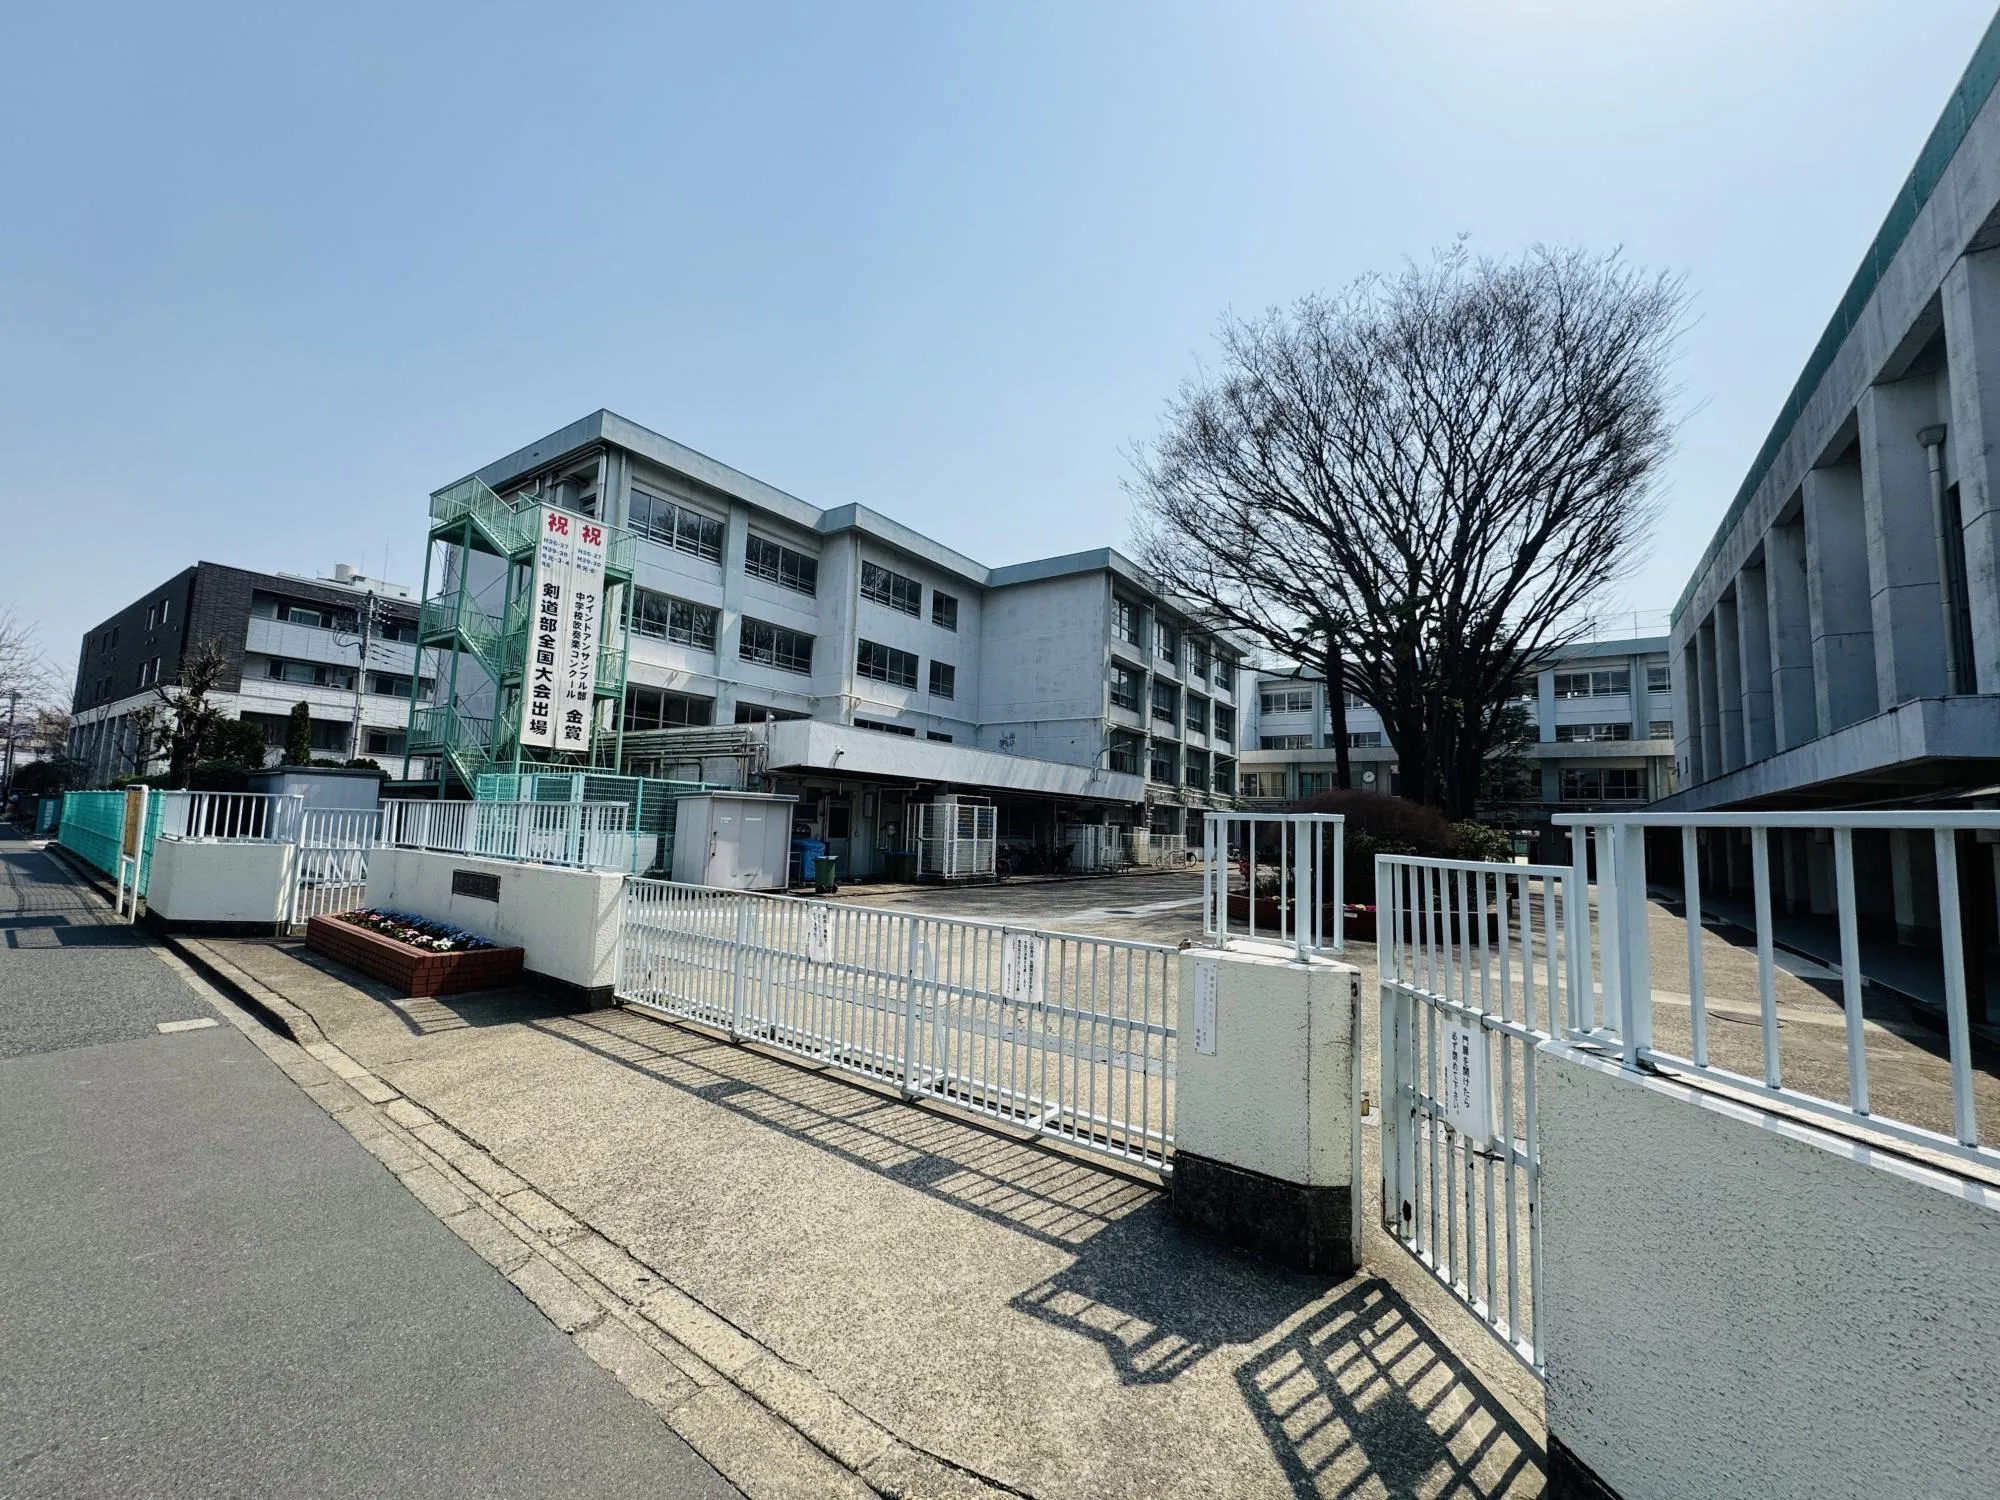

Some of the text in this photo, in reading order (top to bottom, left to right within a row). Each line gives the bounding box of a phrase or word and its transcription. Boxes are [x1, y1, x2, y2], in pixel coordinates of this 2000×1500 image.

[548, 512, 569, 536] 祝
[582, 524, 602, 547] 祝
[530, 582, 560, 736] 剣道部全国大会出場
[566, 592, 586, 699] 中学校吹奏楽コンクール
[564, 709, 583, 742] 金賞
